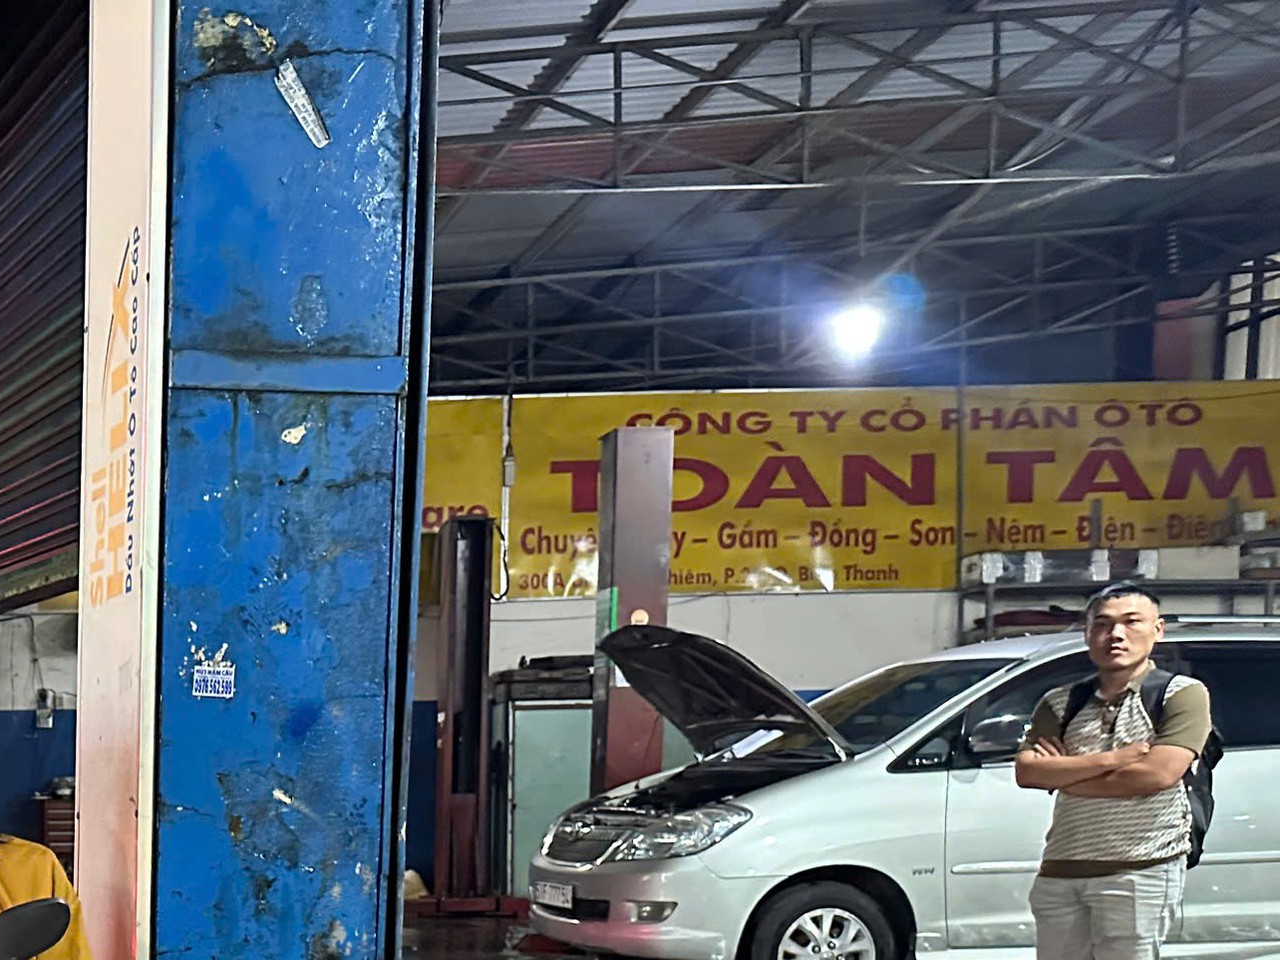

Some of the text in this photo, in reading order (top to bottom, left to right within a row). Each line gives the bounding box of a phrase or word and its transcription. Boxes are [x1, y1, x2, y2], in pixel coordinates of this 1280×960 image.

[130, 296, 138, 355] Cao
[106, 256, 130, 600] HELIX
[626, 407, 773, 436] CÔNG
[789, 411, 846, 433] TY
[860, 396, 927, 433] CỔ
[985, 437, 1277, 503] TÂM
[90, 467, 107, 608] Shell
[520, 526, 598, 562] Chuyê
[909, 518, 955, 547] Sơn
[1076, 515, 1135, 549] Đện
[668, 567, 718, 586] hiêm,
